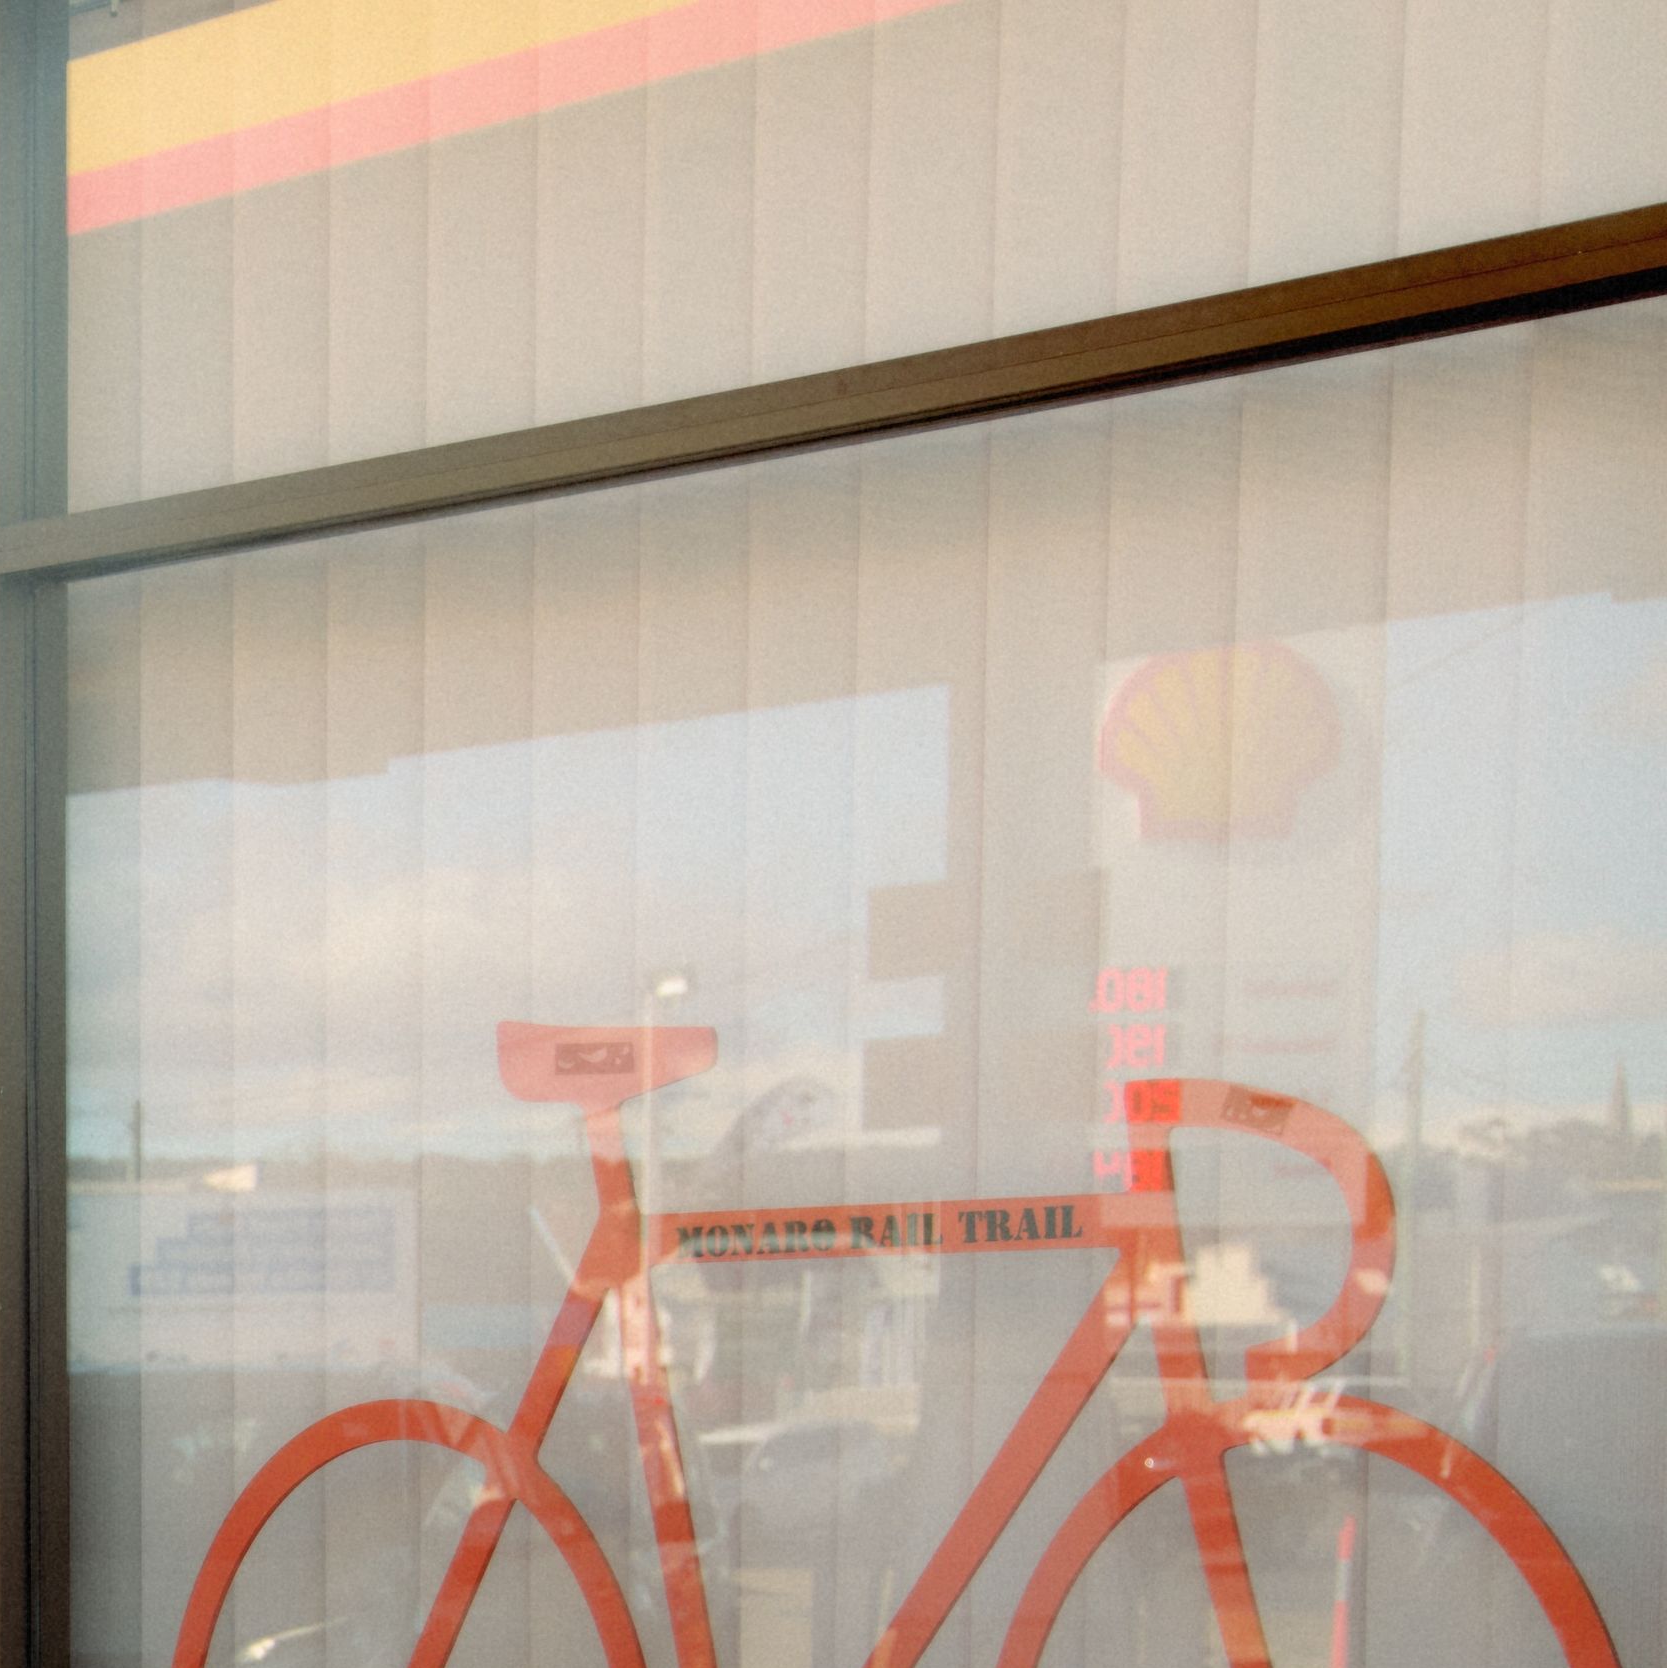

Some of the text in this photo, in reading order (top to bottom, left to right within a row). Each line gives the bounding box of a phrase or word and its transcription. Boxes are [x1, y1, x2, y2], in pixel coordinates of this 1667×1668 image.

[677, 1204, 1084, 1261] MONARO RAIL TRAIL
